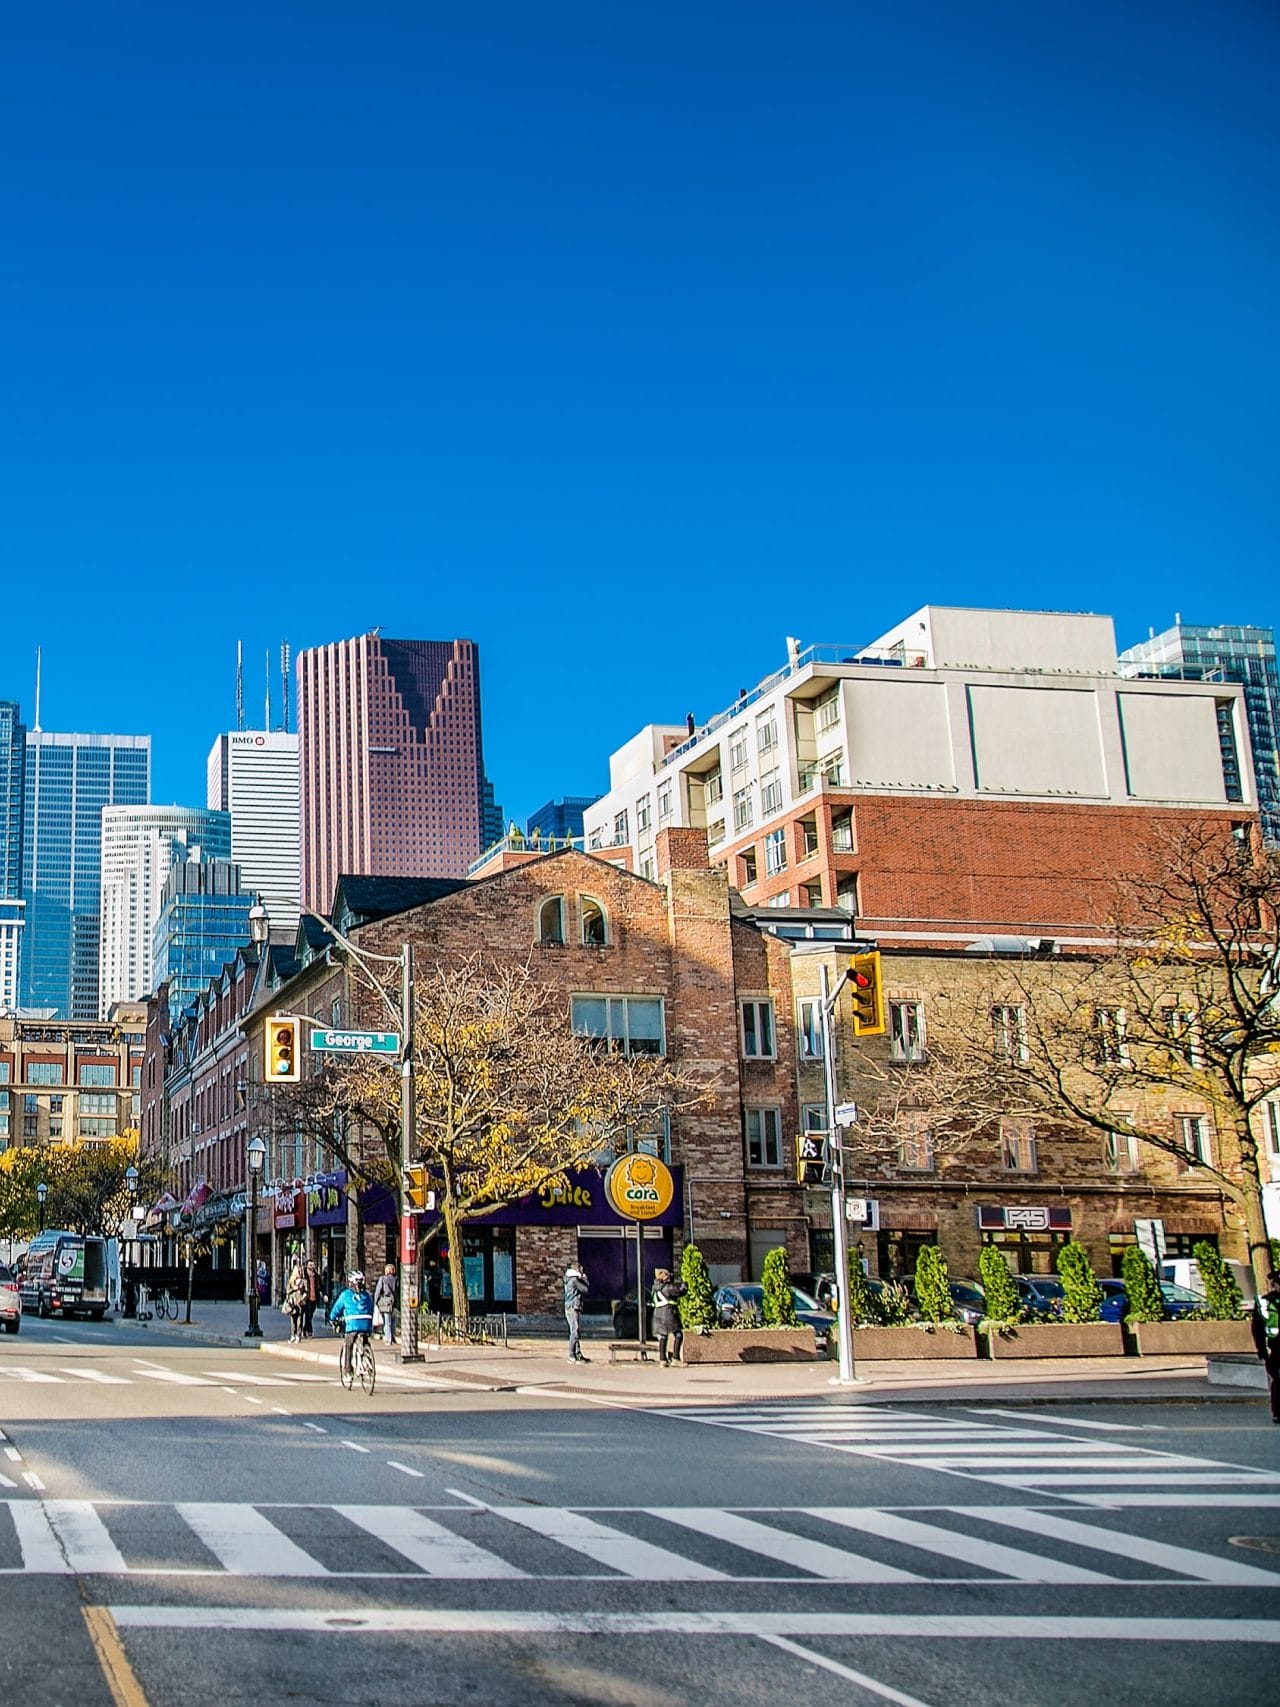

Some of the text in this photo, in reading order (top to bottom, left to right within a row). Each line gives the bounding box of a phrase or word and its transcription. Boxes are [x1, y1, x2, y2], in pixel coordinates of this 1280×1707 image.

[231, 736, 254, 745] BMO
[324, 1030, 373, 1051] George
[541, 1186, 592, 1209] Juice
[626, 1189, 659, 1201] cora
